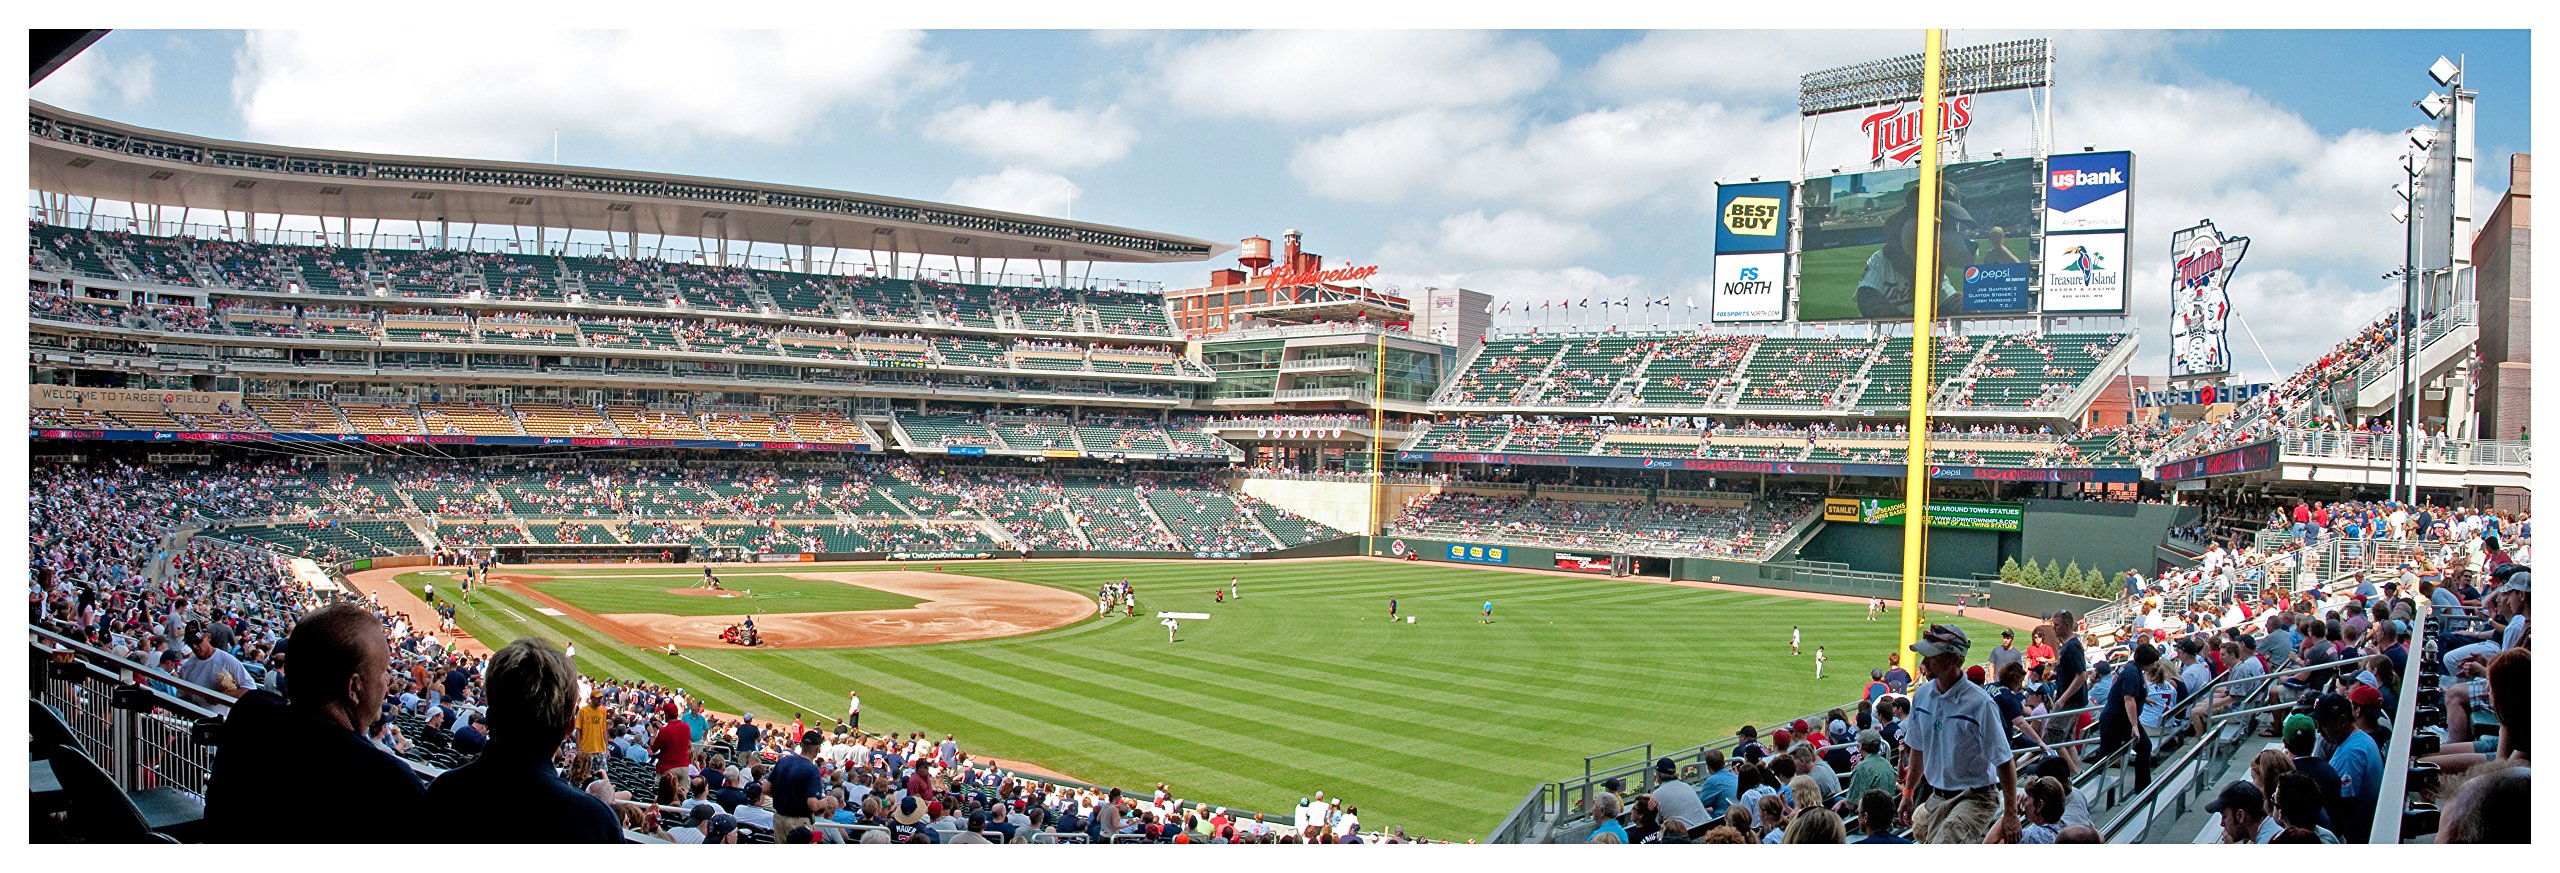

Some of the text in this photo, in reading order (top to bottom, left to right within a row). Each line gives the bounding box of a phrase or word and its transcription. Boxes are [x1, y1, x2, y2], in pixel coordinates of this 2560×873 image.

[1731, 204, 1777, 217] BEST
[1732, 217, 1772, 229] BUY
[1740, 267, 1759, 280] FS
[1981, 268, 2010, 280] pepsi
[2177, 245, 2223, 291] Twins
[1261, 261, 1379, 291] Budweiser
[2050, 272, 2116, 286] Treasure Island
[1724, 281, 1772, 295] NORTH
[43, 389, 210, 403] WELCOME TO TARGET FIELD
[2136, 388, 2200, 407] TARGET
[1653, 460, 1672, 468] pepsi
[1941, 468, 1961, 477] pepsi
[1828, 506, 1856, 514] STANLEY
[1880, 503, 1906, 513] SEASONS
[2162, 693, 2171, 711] 7
[896, 825, 917, 834] MAUER
